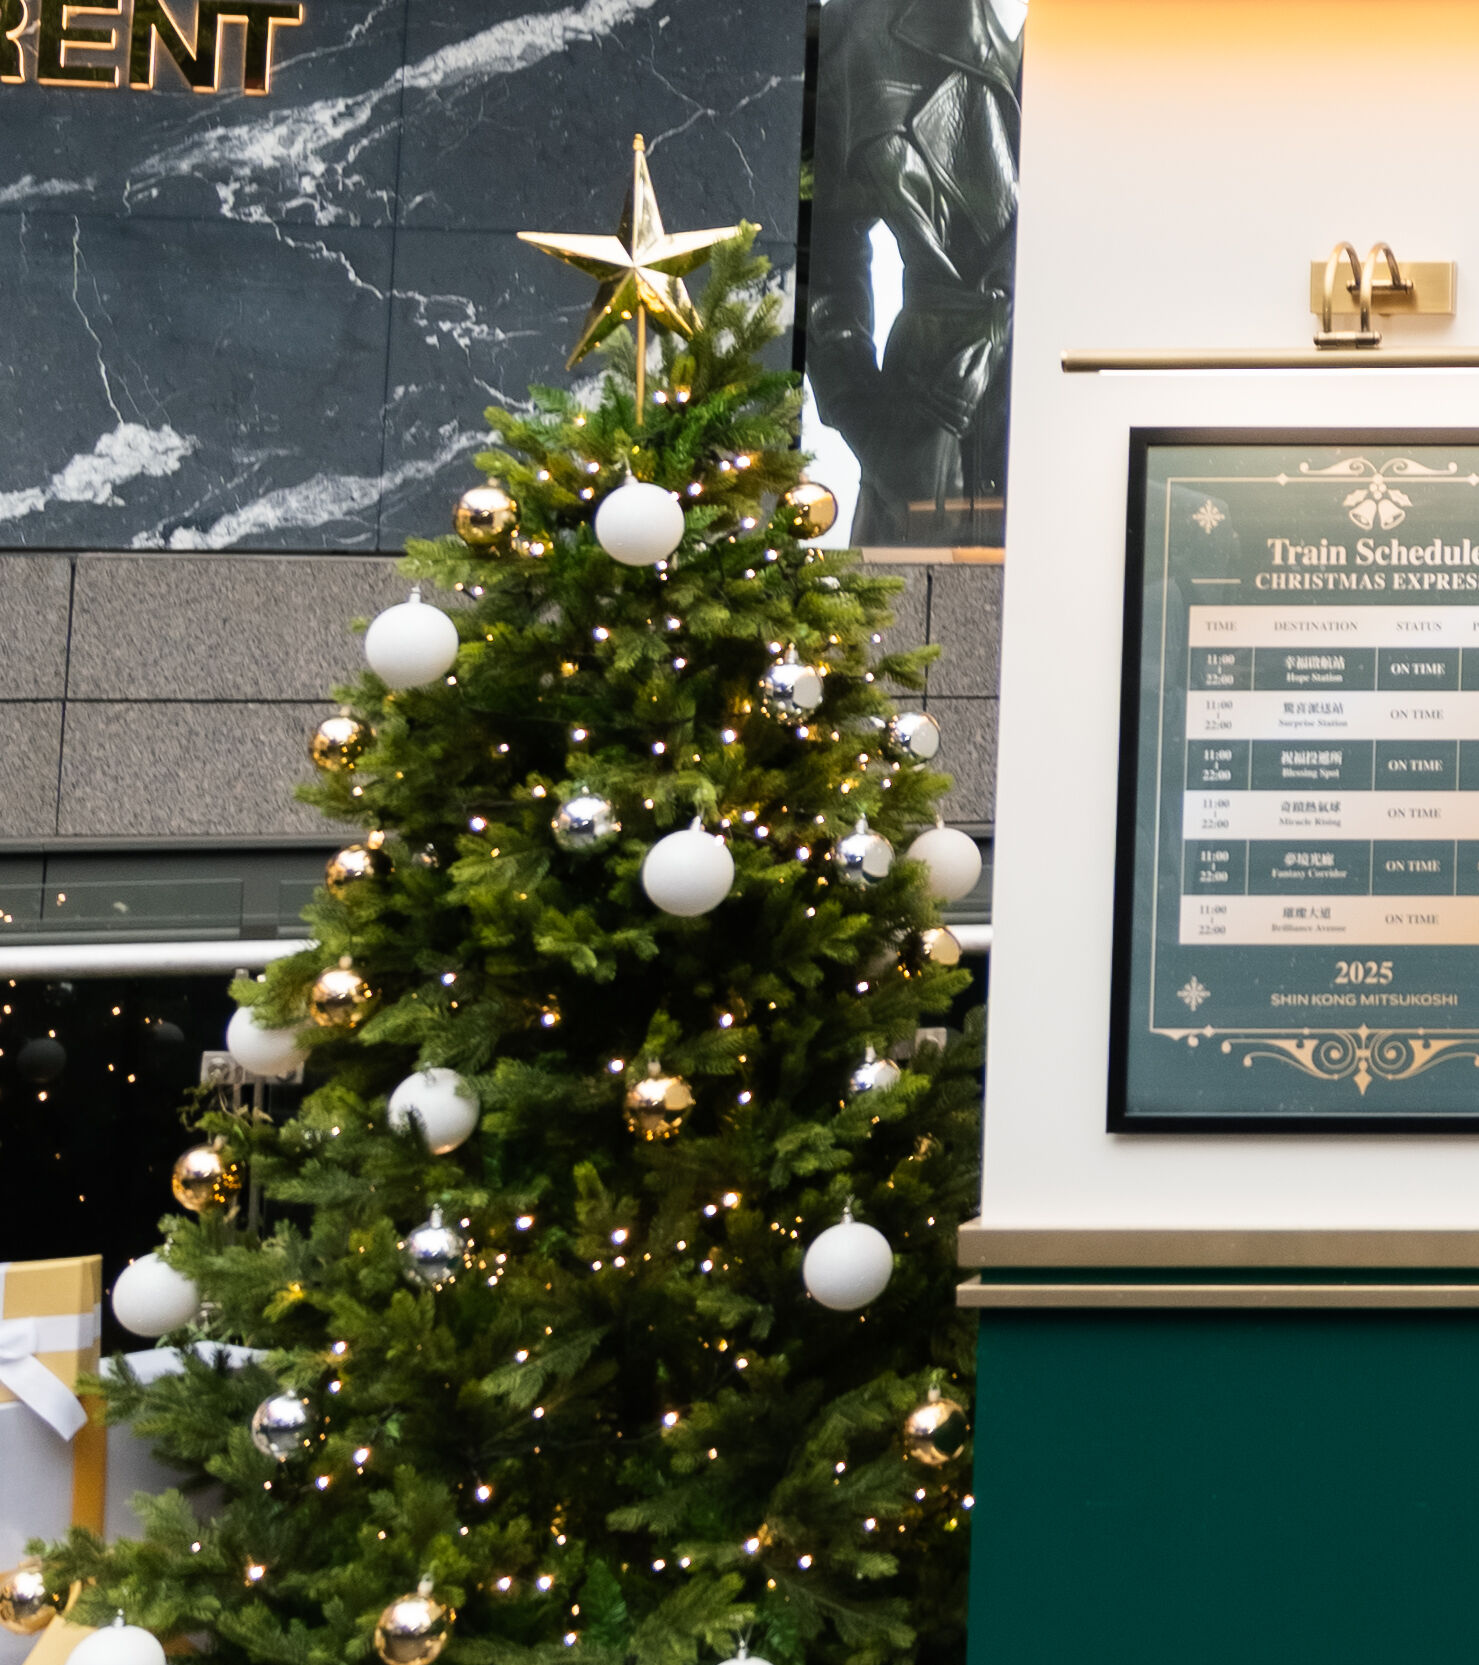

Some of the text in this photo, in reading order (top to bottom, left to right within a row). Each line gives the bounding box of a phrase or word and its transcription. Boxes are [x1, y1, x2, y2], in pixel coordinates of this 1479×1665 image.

[1269, 538, 1347, 566] Train
[1255, 573, 1385, 590] CHRISTMAS
[1205, 621, 1237, 631] TIME
[1274, 621, 1358, 631] DESTINATION
[1396, 621, 1442, 631] STATUS
[1206, 654, 1235, 666] 11:00
[1391, 663, 1445, 675] ON TIME
[1206, 674, 1234, 686] 22:00
[1205, 700, 1233, 711] 11:00
[1390, 709, 1443, 720] ON TIME
[1205, 720, 1232, 730] 22:00
[1203, 750, 1231, 761] 11:00
[1388, 760, 1443, 771] ON TIME
[1203, 770, 1231, 782] 22:00
[1202, 798, 1230, 809] 11:00
[1387, 808, 1441, 819] ON TIME
[1201, 819, 1229, 829] 22:00
[1201, 851, 1229, 862] 11:00
[1386, 860, 1441, 872] ON TIME
[1200, 871, 1228, 883] 22:00
[1199, 904, 1227, 915] 11:00
[1385, 914, 1438, 924] ON TIME
[1199, 925, 1226, 935] 22:00
[1335, 961, 1393, 985] 2025
[1271, 994, 1458, 1006] SHIN KONG MITSUKOSHI
